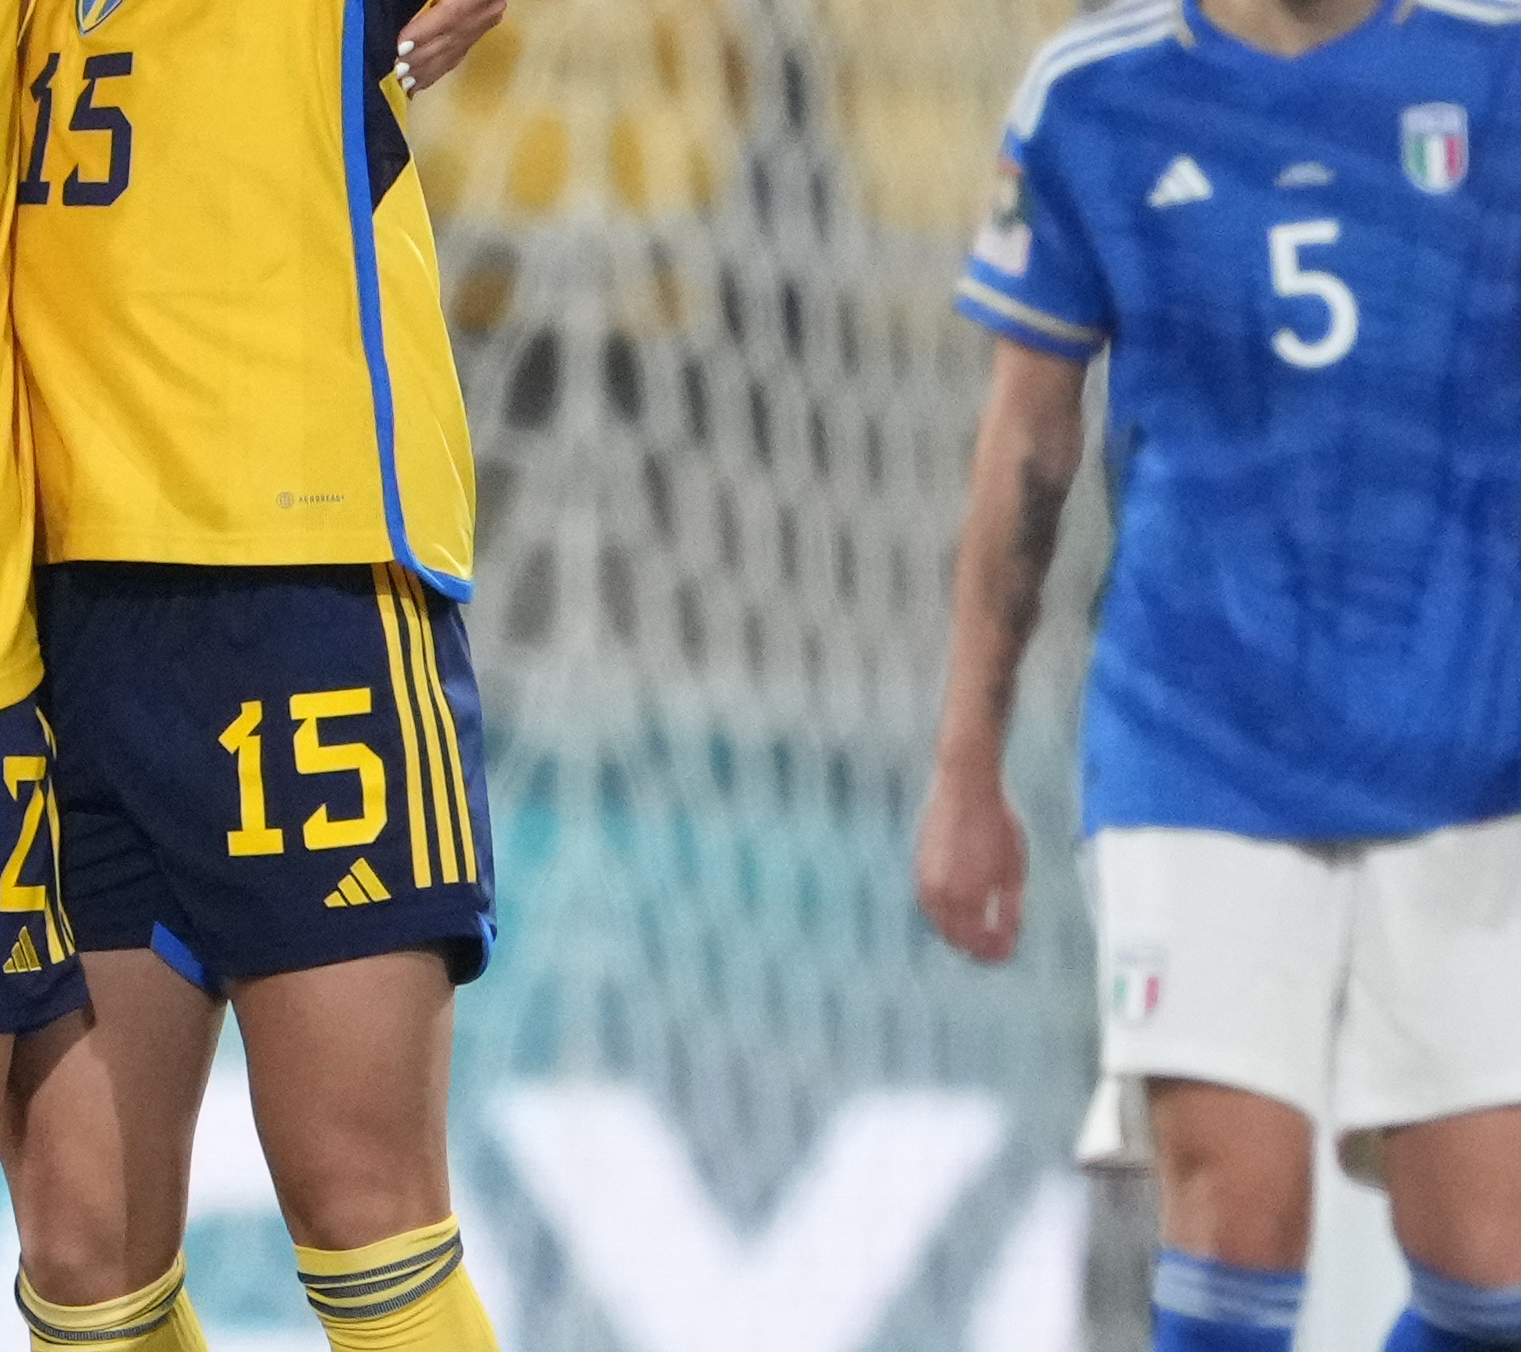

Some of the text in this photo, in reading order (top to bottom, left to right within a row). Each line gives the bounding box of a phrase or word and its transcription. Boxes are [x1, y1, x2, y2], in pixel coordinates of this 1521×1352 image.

[18, 51, 133, 206] 15
[1266, 218, 1359, 370] 5
[218, 687, 389, 857] 15
